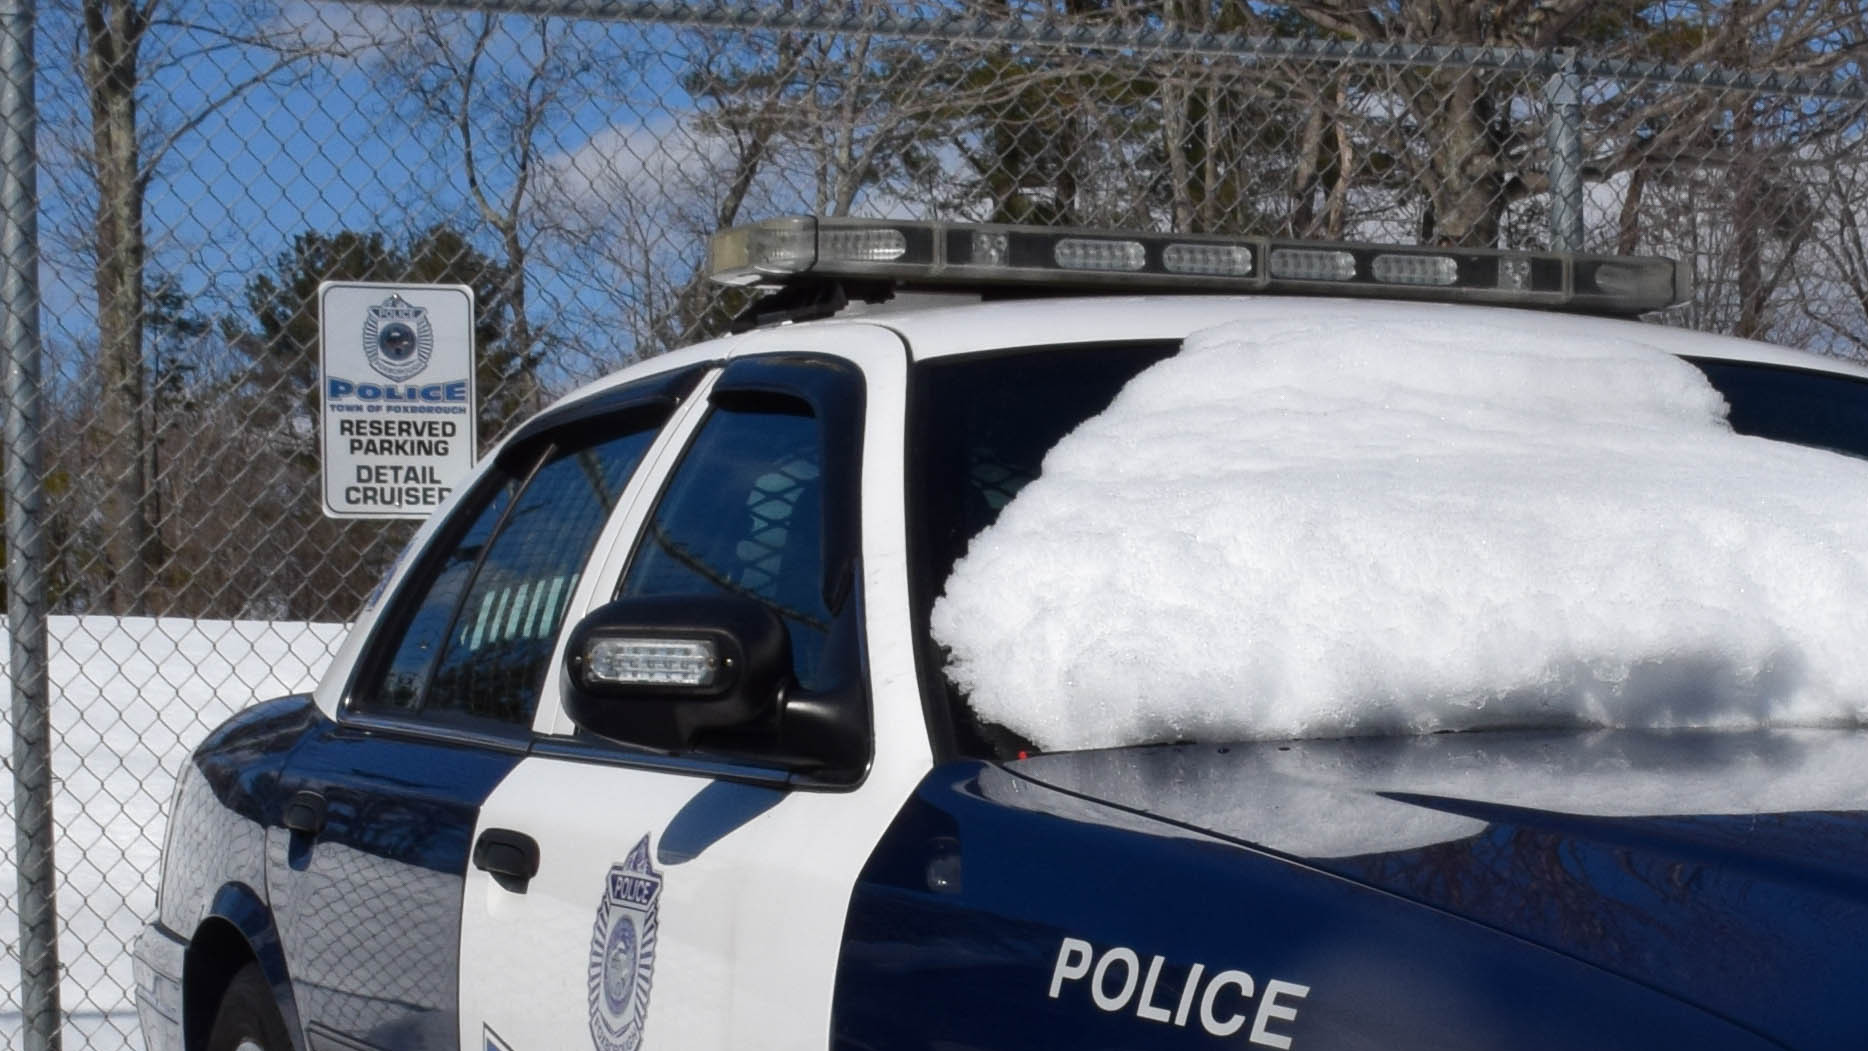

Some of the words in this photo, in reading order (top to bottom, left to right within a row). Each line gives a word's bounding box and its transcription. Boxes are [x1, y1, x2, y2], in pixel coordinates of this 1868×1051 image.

[328, 376, 468, 403] POLICE
[331, 404, 363, 413] TOWN
[367, 405, 383, 413] OF
[386, 405, 466, 414] FOXBOROUGH
[340, 419, 456, 437] RESERVED
[350, 439, 449, 456] PARKING
[356, 465, 442, 484] DETAIL
[614, 876, 652, 904] POLICE
[1048, 937, 1311, 1050] POLICE
